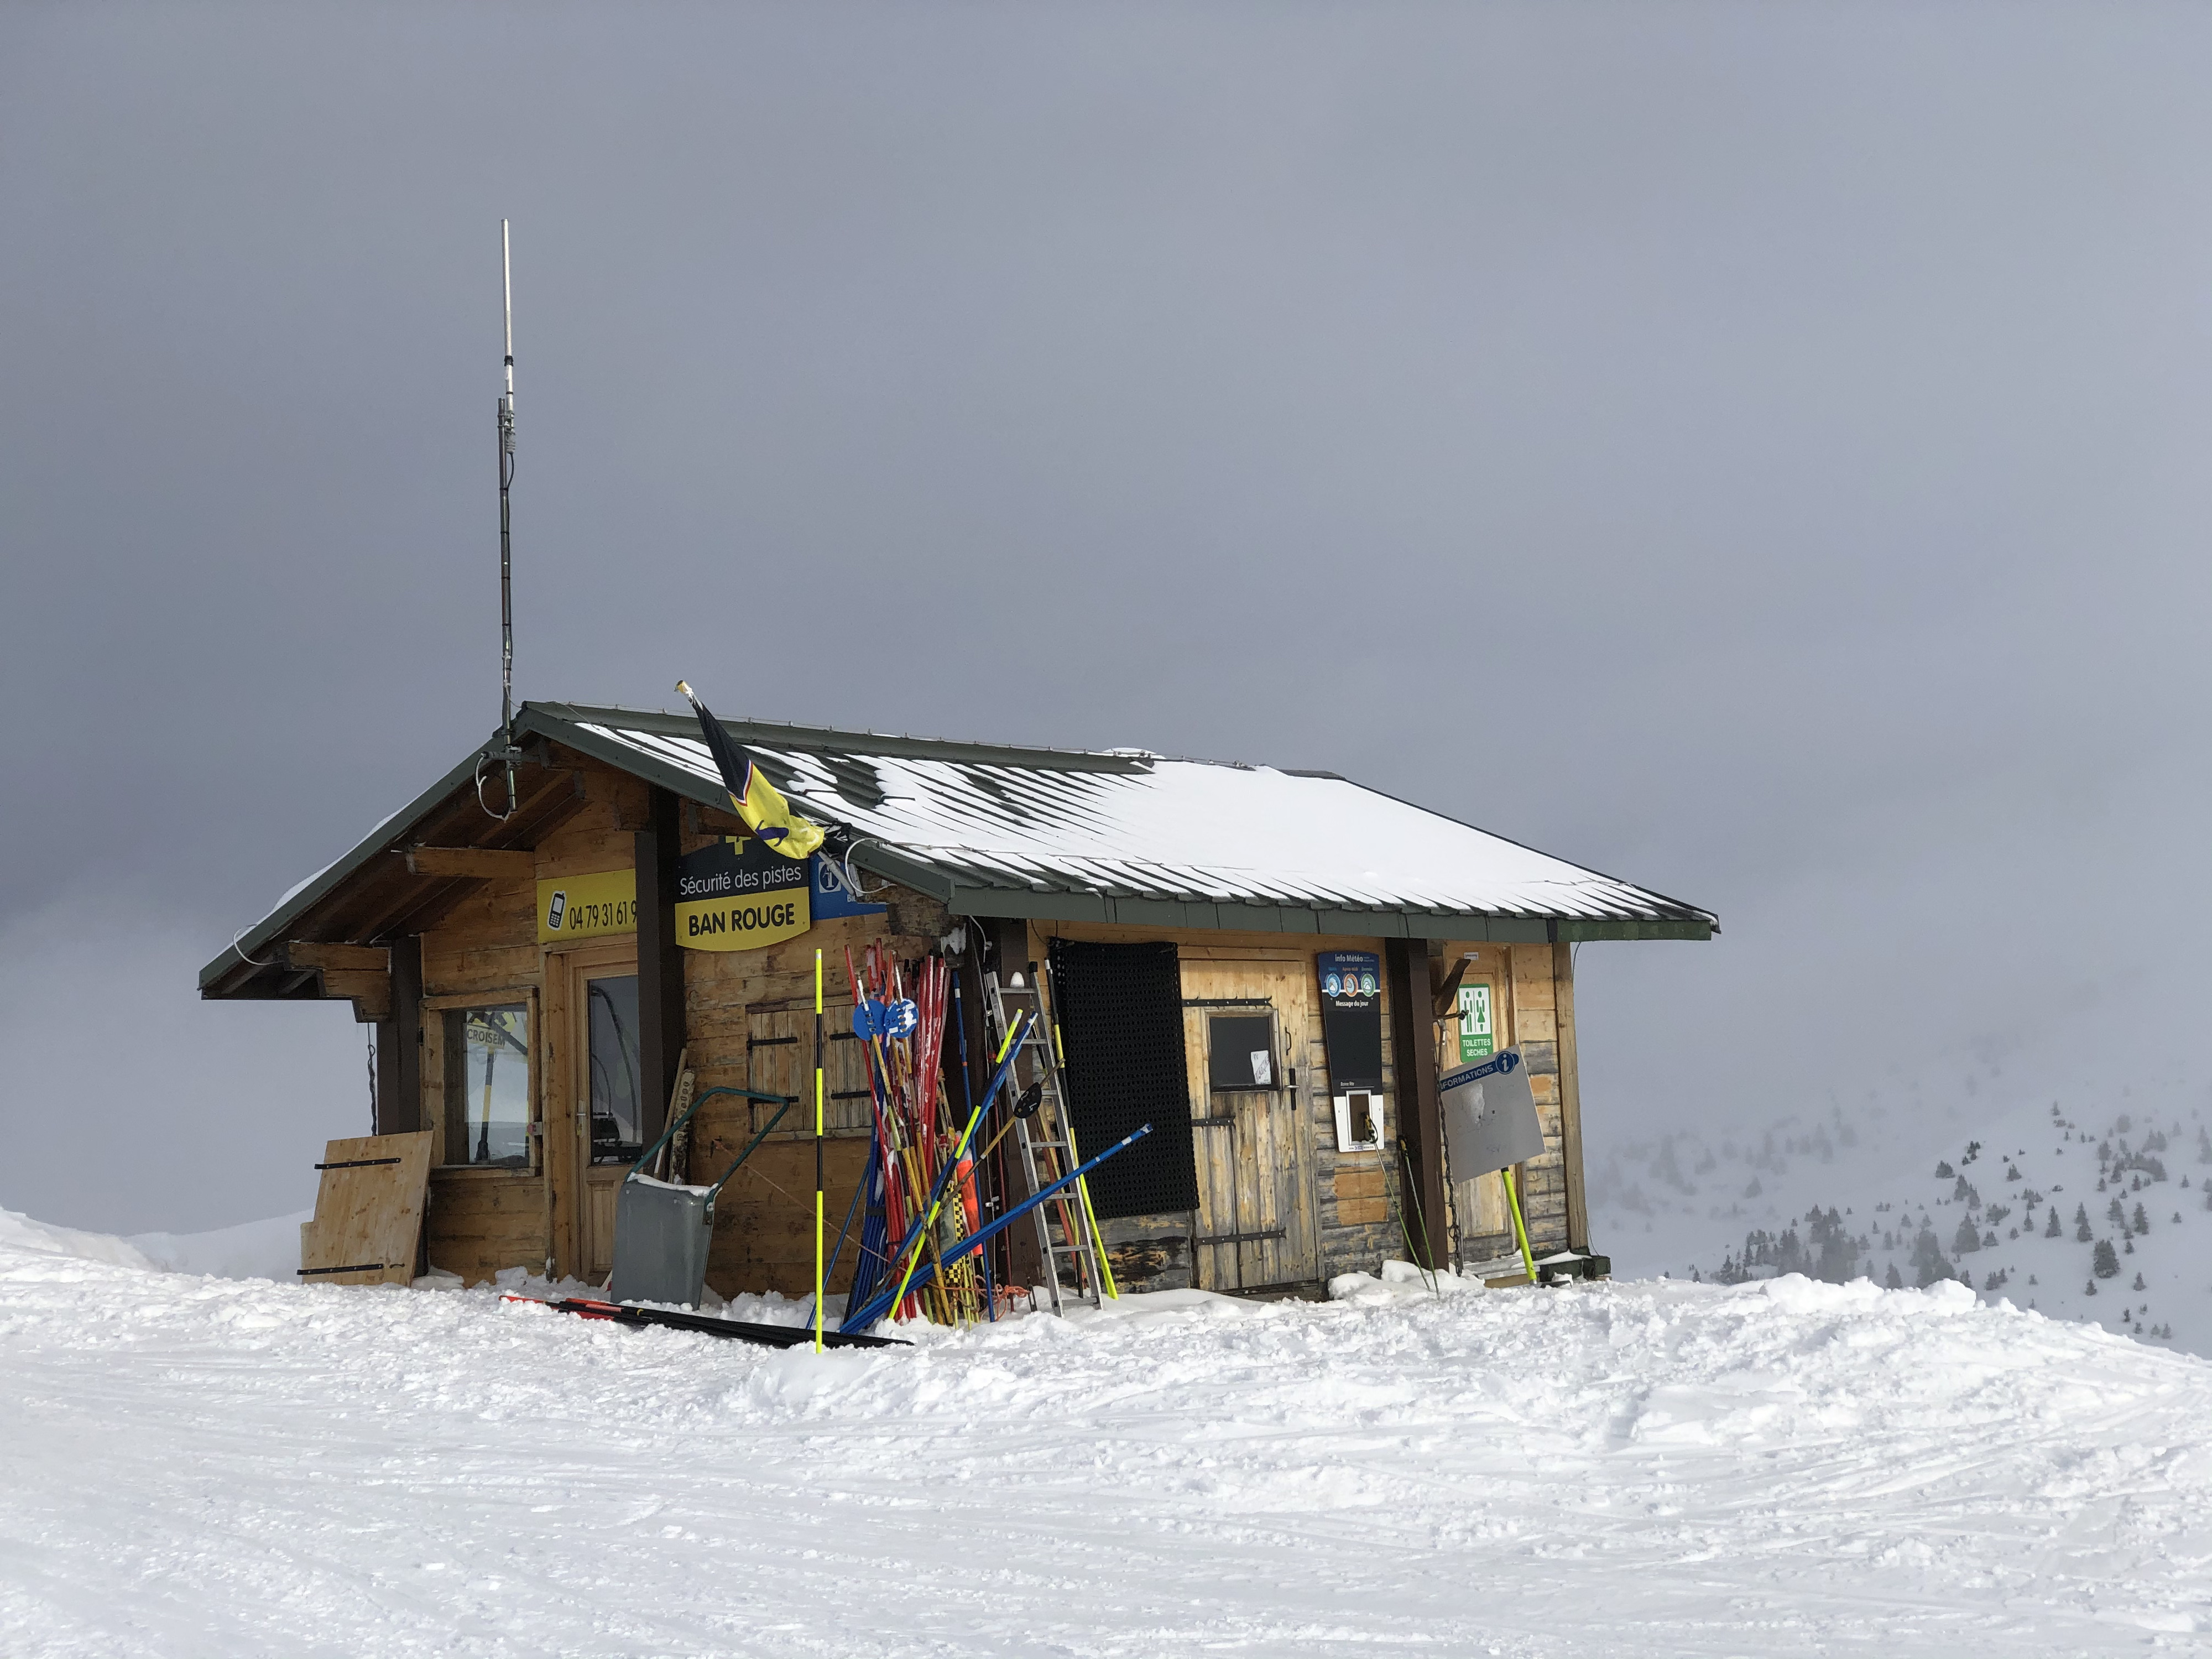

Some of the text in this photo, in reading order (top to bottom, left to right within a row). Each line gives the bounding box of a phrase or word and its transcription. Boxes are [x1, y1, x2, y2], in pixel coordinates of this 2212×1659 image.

[680, 865, 801, 895] Sécurité des pistes
[570, 906, 583, 930] 04
[586, 905, 599, 928] 79
[602, 902, 613, 926] 31
[616, 901, 627, 925] 61
[688, 903, 795, 936] BAN ROUGE
[1462, 1039, 1491, 1047] TOILETTES
[1467, 1048, 1488, 1056] SECHES
